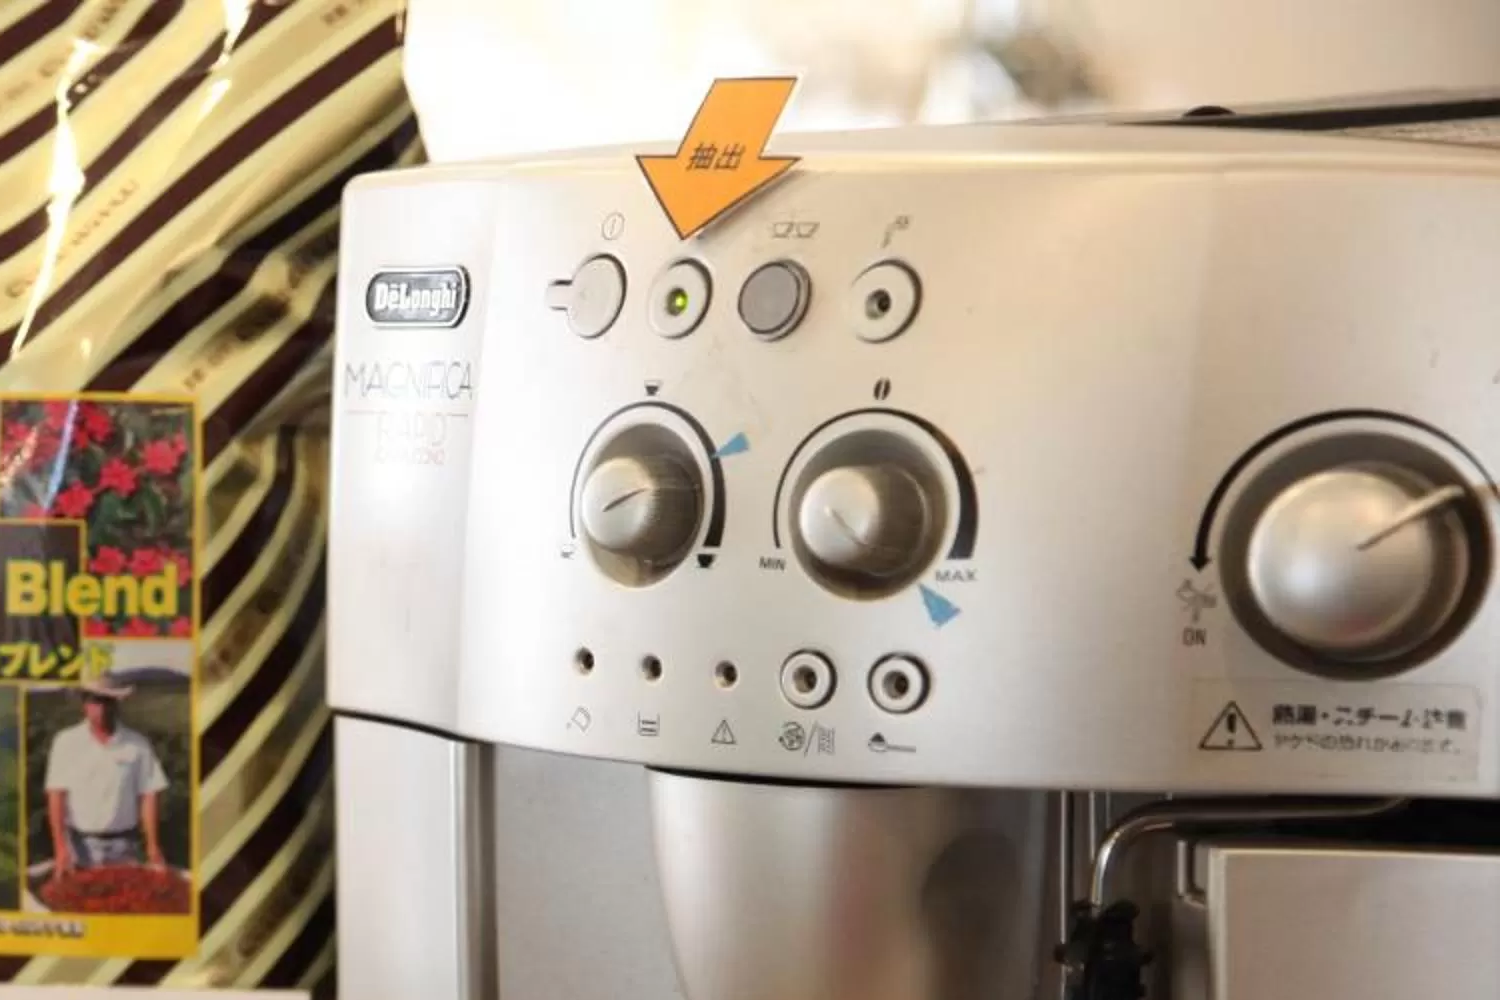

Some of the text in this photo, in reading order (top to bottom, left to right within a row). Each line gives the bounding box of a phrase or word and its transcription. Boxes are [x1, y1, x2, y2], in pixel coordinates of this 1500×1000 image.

[685, 143, 746, 171] 抽出
[759, 556, 786, 571] MIN
[935, 569, 978, 583] MAX
[5, 560, 180, 617] Blend
[1182, 628, 1207, 647] ON
